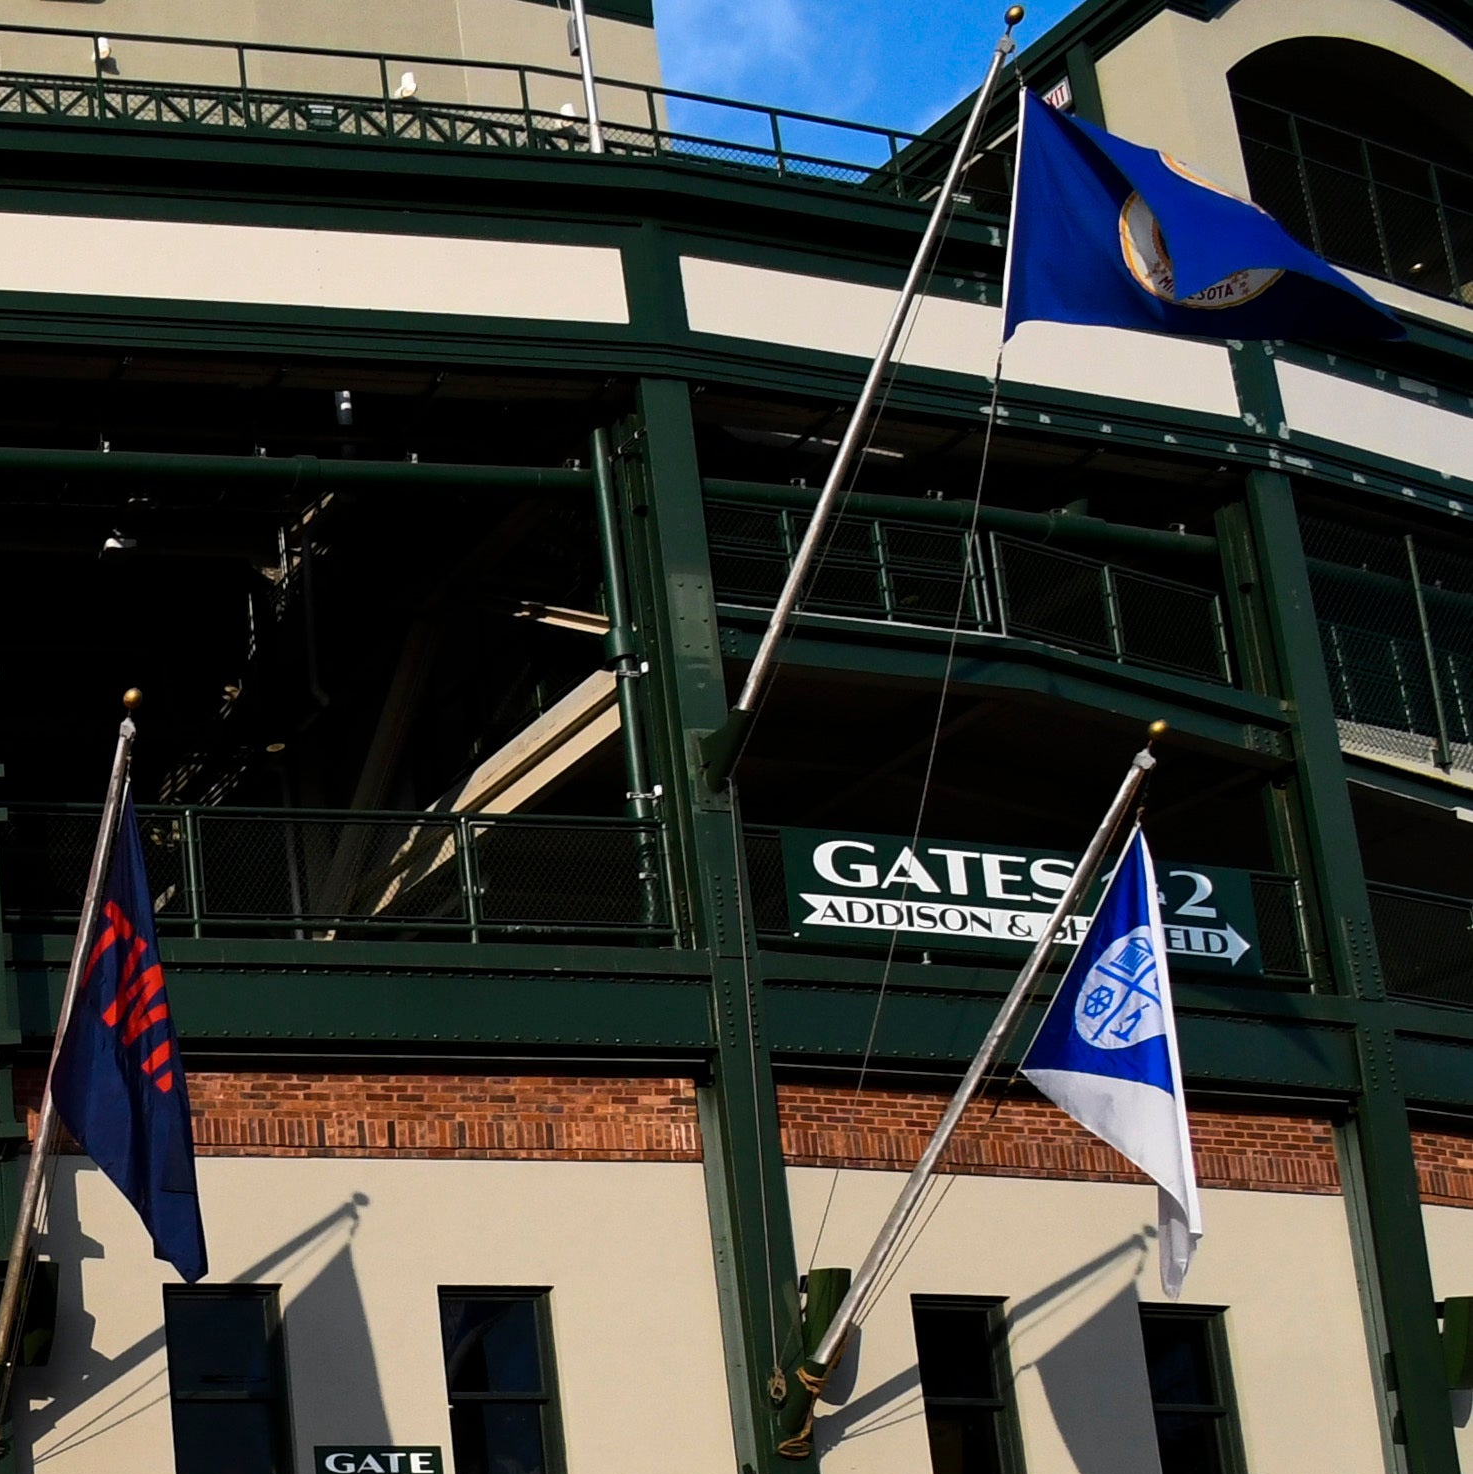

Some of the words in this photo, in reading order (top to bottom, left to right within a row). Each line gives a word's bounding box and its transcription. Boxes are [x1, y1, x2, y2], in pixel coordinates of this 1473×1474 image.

[812, 840, 1077, 904] GATES
[1169, 870, 1218, 918] 2
[819, 900, 994, 934] ADDISON
[1006, 914, 1033, 938] &
[324, 1452, 435, 1474] GATE
